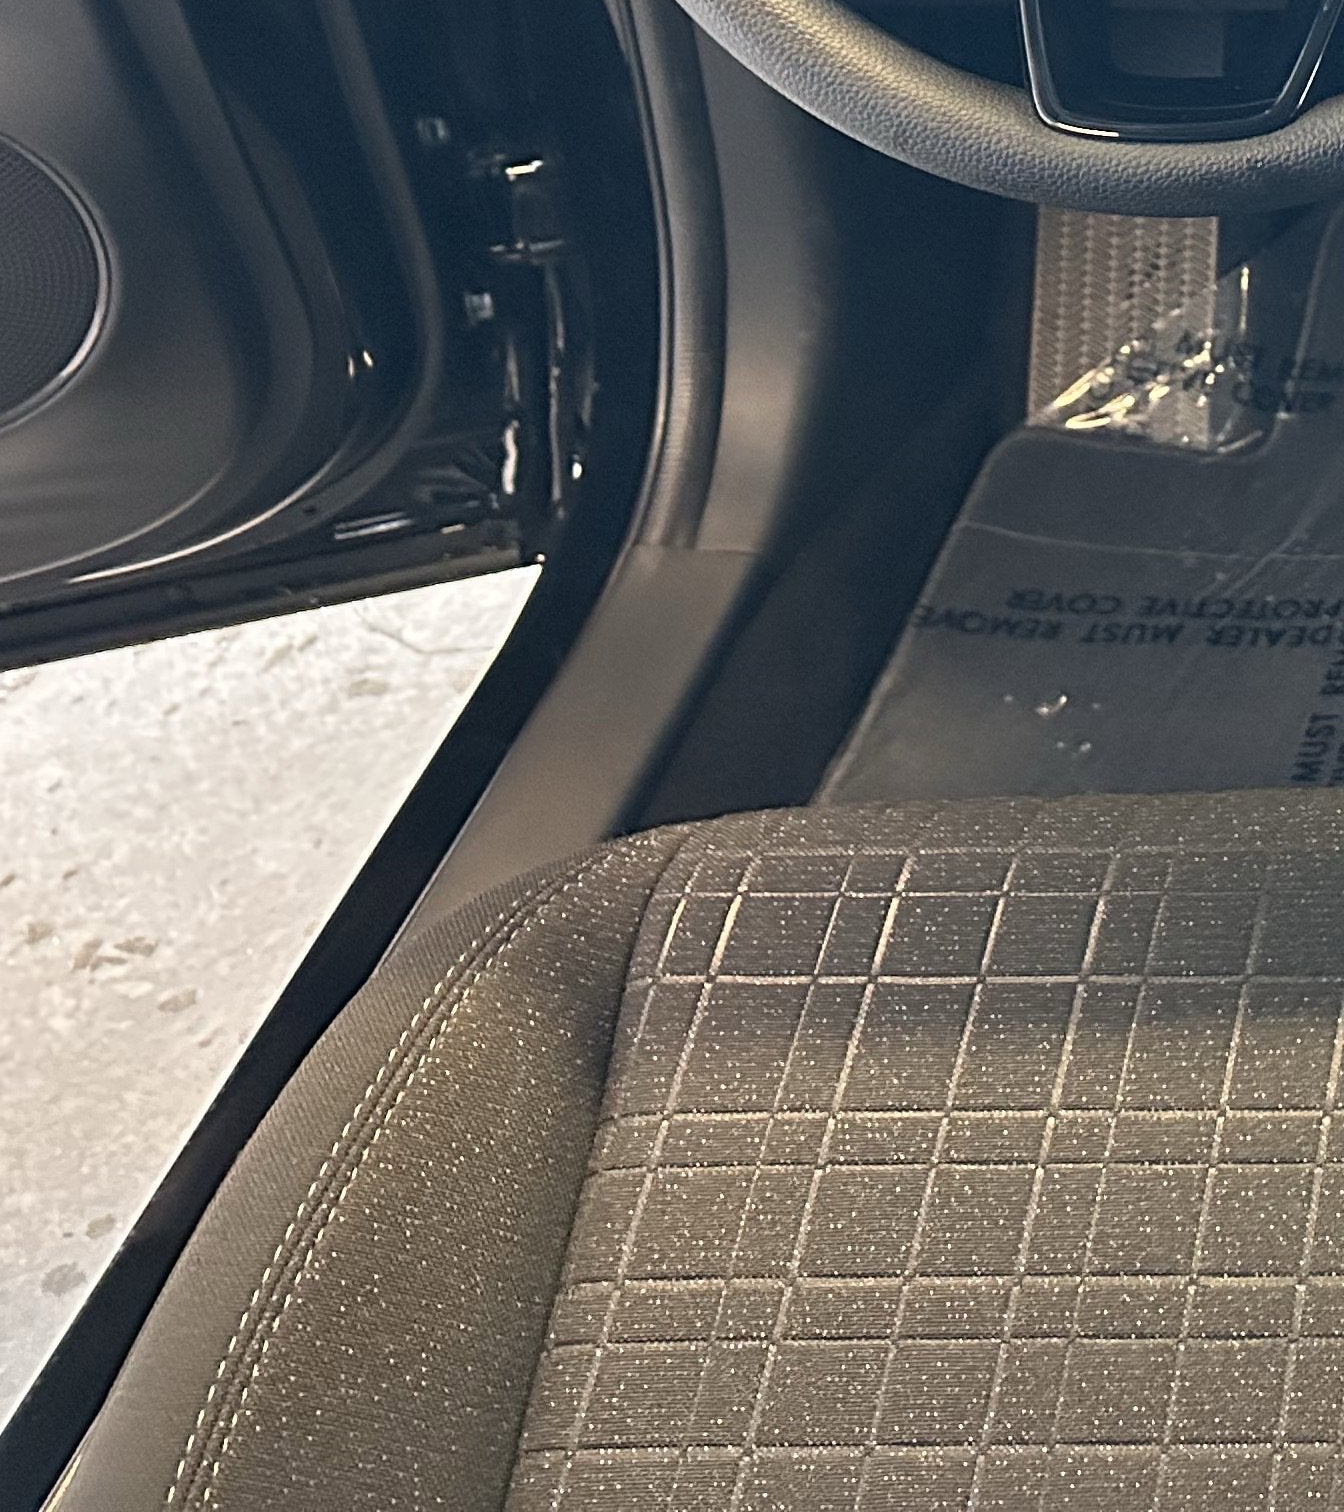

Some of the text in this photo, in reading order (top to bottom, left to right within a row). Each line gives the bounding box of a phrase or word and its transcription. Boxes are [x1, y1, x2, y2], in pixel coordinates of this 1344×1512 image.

[1005, 588, 1126, 616] COVER
[1077, 620, 1186, 646] MUST
[1204, 622, 1336, 649] DEALER
[1290, 711, 1343, 785] MUST
